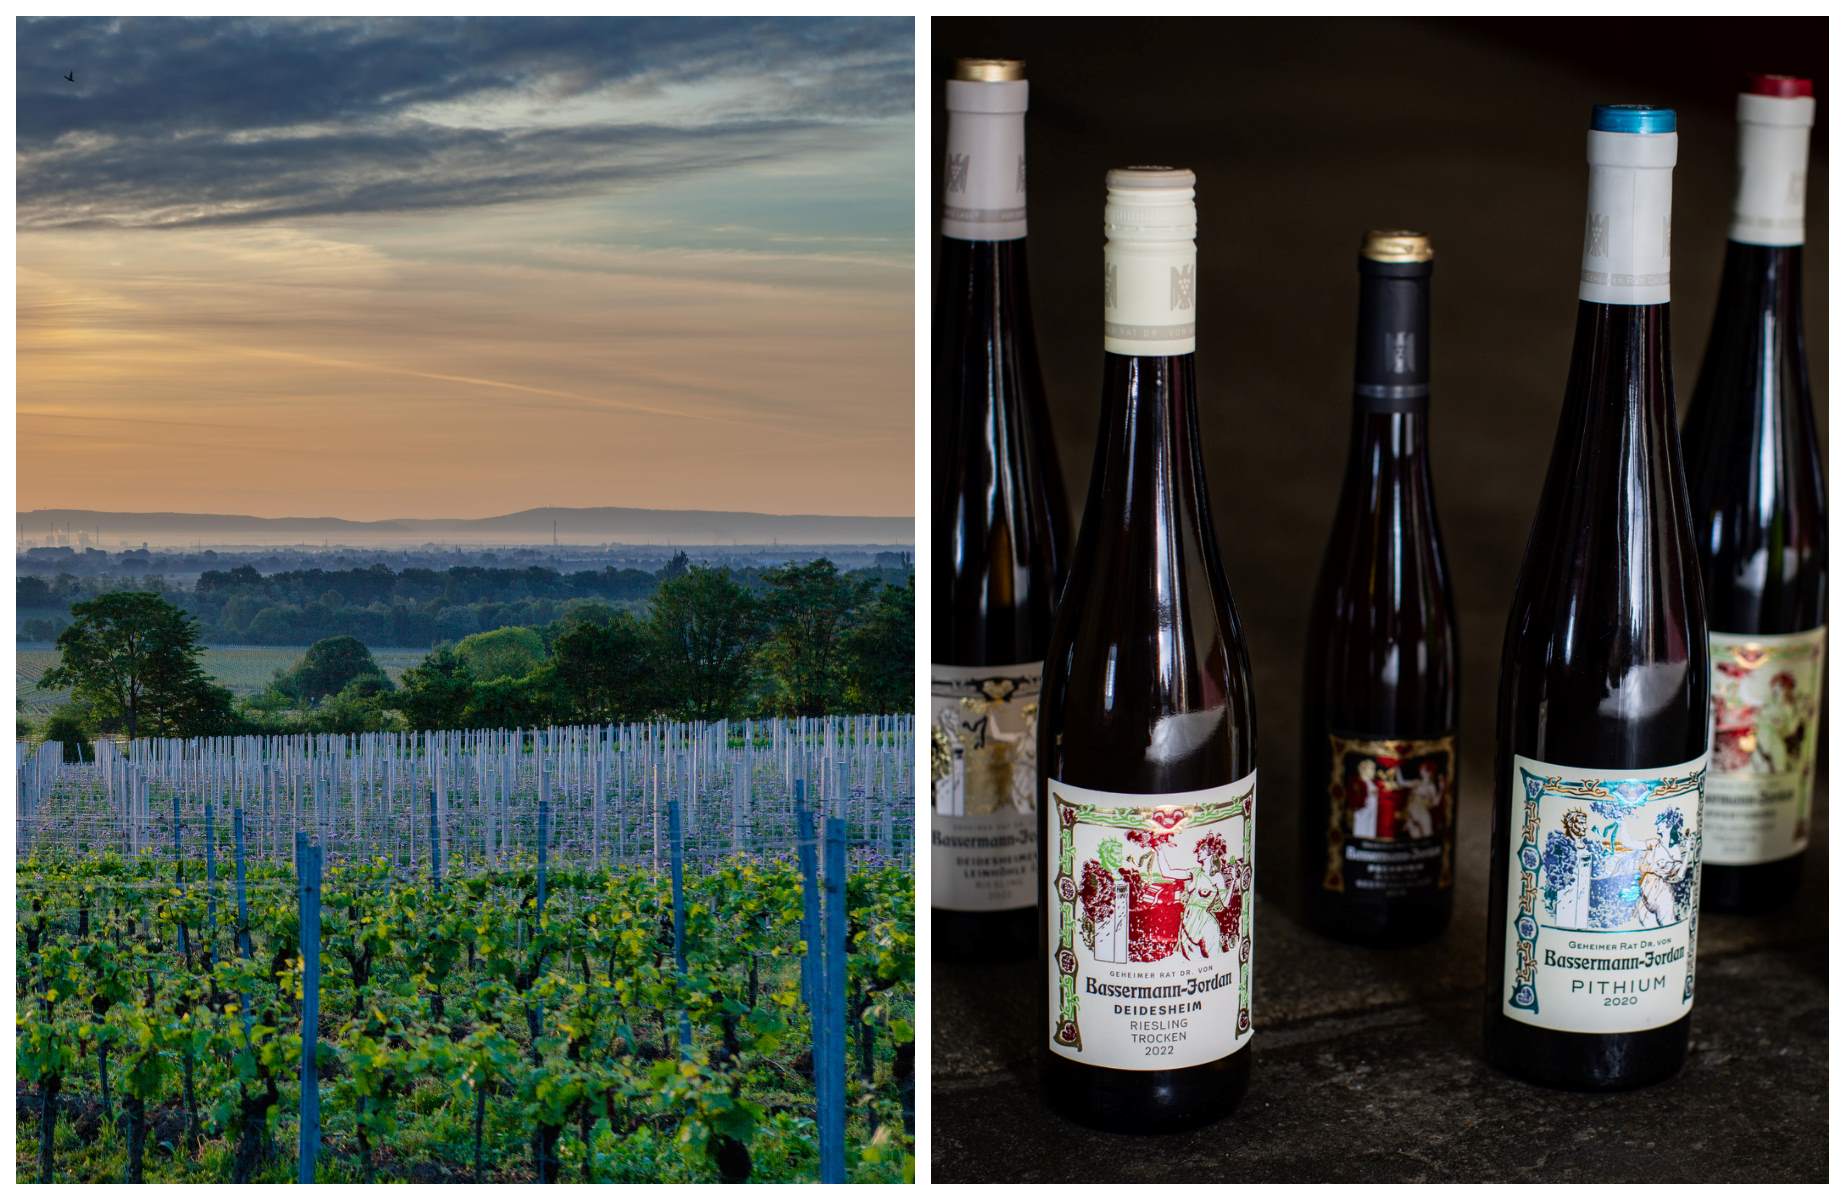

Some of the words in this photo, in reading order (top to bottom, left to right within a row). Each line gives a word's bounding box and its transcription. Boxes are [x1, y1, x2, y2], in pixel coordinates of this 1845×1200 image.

[1544, 945, 1685, 971] Bassermann-Jordan
[1109, 970, 1155, 979] GEHEIMER
[1198, 965, 1213, 974] VON
[1086, 972, 1232, 999] Bassermann-Jordan
[1572, 975, 1666, 995] PITHIUM
[1114, 1000, 1203, 1016] DEIDESHEIM
[1603, 996, 1638, 1006] 2020
[1130, 1018, 1188, 1031] RIESLING
[1131, 1031, 1187, 1044] TROCKEN
[1144, 1045, 1175, 1057] 2022
